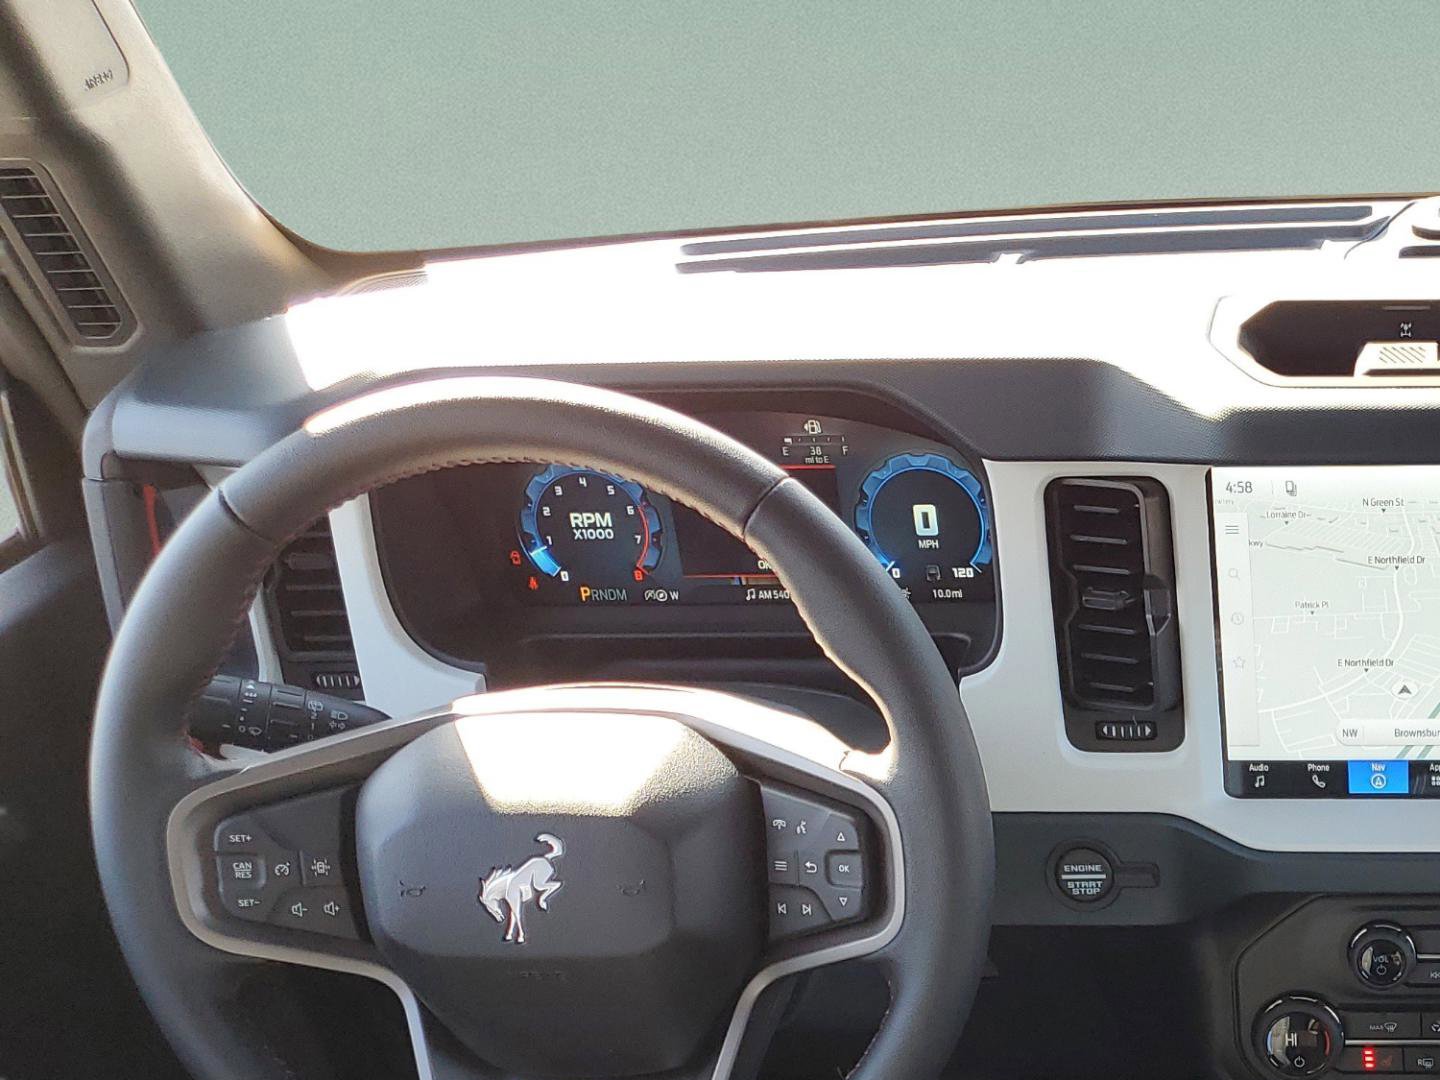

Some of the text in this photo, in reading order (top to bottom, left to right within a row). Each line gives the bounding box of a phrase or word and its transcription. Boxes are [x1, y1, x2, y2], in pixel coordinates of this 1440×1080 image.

[782, 446, 789, 456] E
[810, 446, 822, 456] 38
[842, 445, 849, 455] F
[578, 477, 587, 487] 4
[554, 486, 563, 496] 3
[607, 485, 615, 495] 5
[1225, 481, 1253, 494] 4:58
[1362, 497, 1405, 507] N Green St
[543, 506, 551, 516] 2
[627, 505, 635, 515] 6
[569, 512, 613, 528] RPM
[912, 504, 939, 536] 0
[573, 528, 614, 540] X1000
[546, 536, 553, 545] 1
[634, 535, 641, 544] 7
[918, 539, 939, 549] MPH
[1367, 555, 1425, 564] E Northfield Dr
[560, 571, 569, 582] 0
[891, 567, 901, 578] 0
[952, 567, 975, 578] 120
[580, 586, 627, 601] PRNDM
[670, 590, 679, 600] W
[758, 589, 790, 600] AM 540
[1344, 658, 1384, 667] Northfield
[1385, 658, 1394, 667] Dr
[1342, 728, 1358, 737] NW
[1249, 763, 1269, 772] Audio
[1307, 763, 1330, 772] Phone
[1371, 763, 1385, 772] Nav
[229, 834, 252, 843] SET+
[232, 862, 252, 870] CAN
[838, 864, 850, 873] OK
[1064, 865, 1102, 873] ENGINE
[235, 871, 252, 879] RES
[1067, 881, 1103, 889] START
[1072, 887, 1101, 895] STOP
[1373, 954, 1389, 963] VOL
[1285, 1032, 1298, 1047] HI
